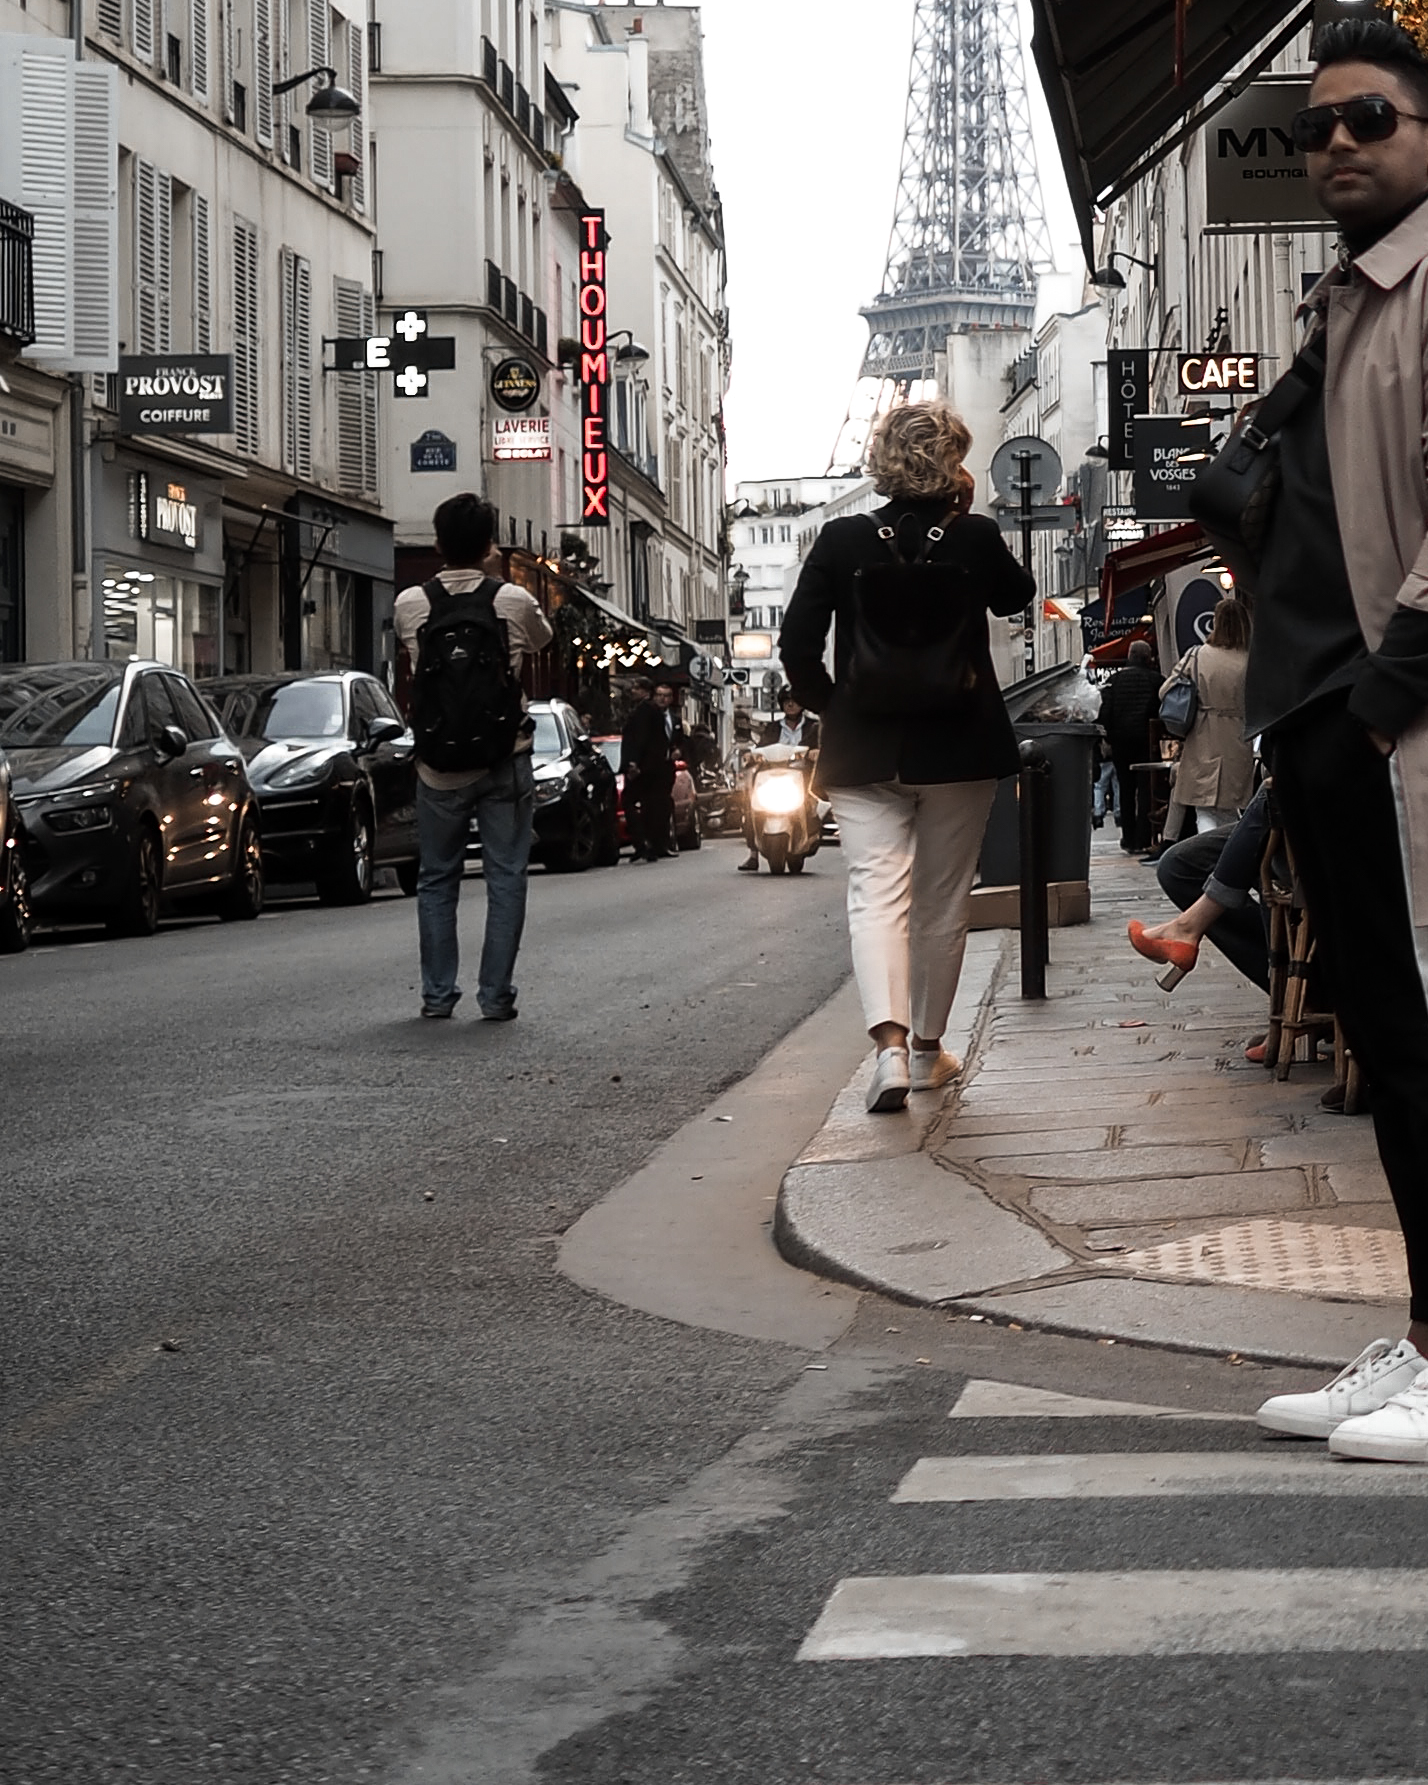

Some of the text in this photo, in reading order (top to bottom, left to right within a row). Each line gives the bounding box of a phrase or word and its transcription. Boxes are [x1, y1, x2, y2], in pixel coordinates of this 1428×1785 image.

[366, 337, 391, 368] E
[155, 367, 197, 377] FRANCK
[580, 216, 607, 518] THOUMIEUX
[1181, 357, 1256, 391] CAFE
[124, 375, 226, 396] PROVOST
[140, 409, 211, 423] COIFFURE
[1121, 360, 1137, 460] HÔTEL
[495, 419, 550, 434] LAVERIE
[1149, 468, 1197, 481] VOSGES
